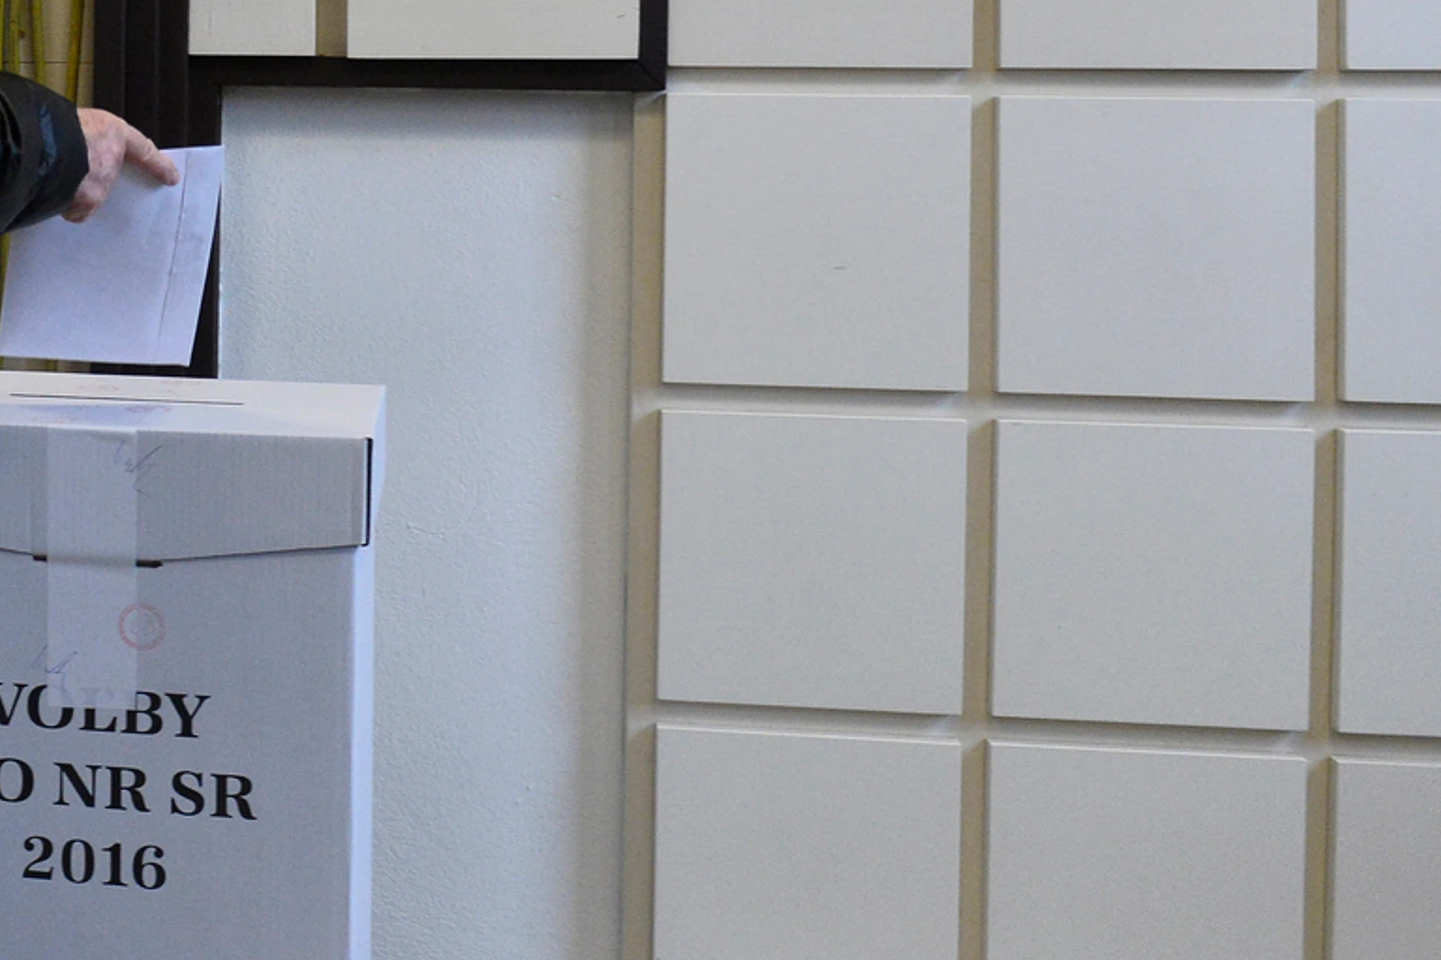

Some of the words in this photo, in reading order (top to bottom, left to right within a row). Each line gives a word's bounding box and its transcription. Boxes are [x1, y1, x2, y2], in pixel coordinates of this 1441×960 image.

[52, 761, 151, 813] NR
[170, 770, 258, 821] SR
[21, 835, 167, 891] 2016
